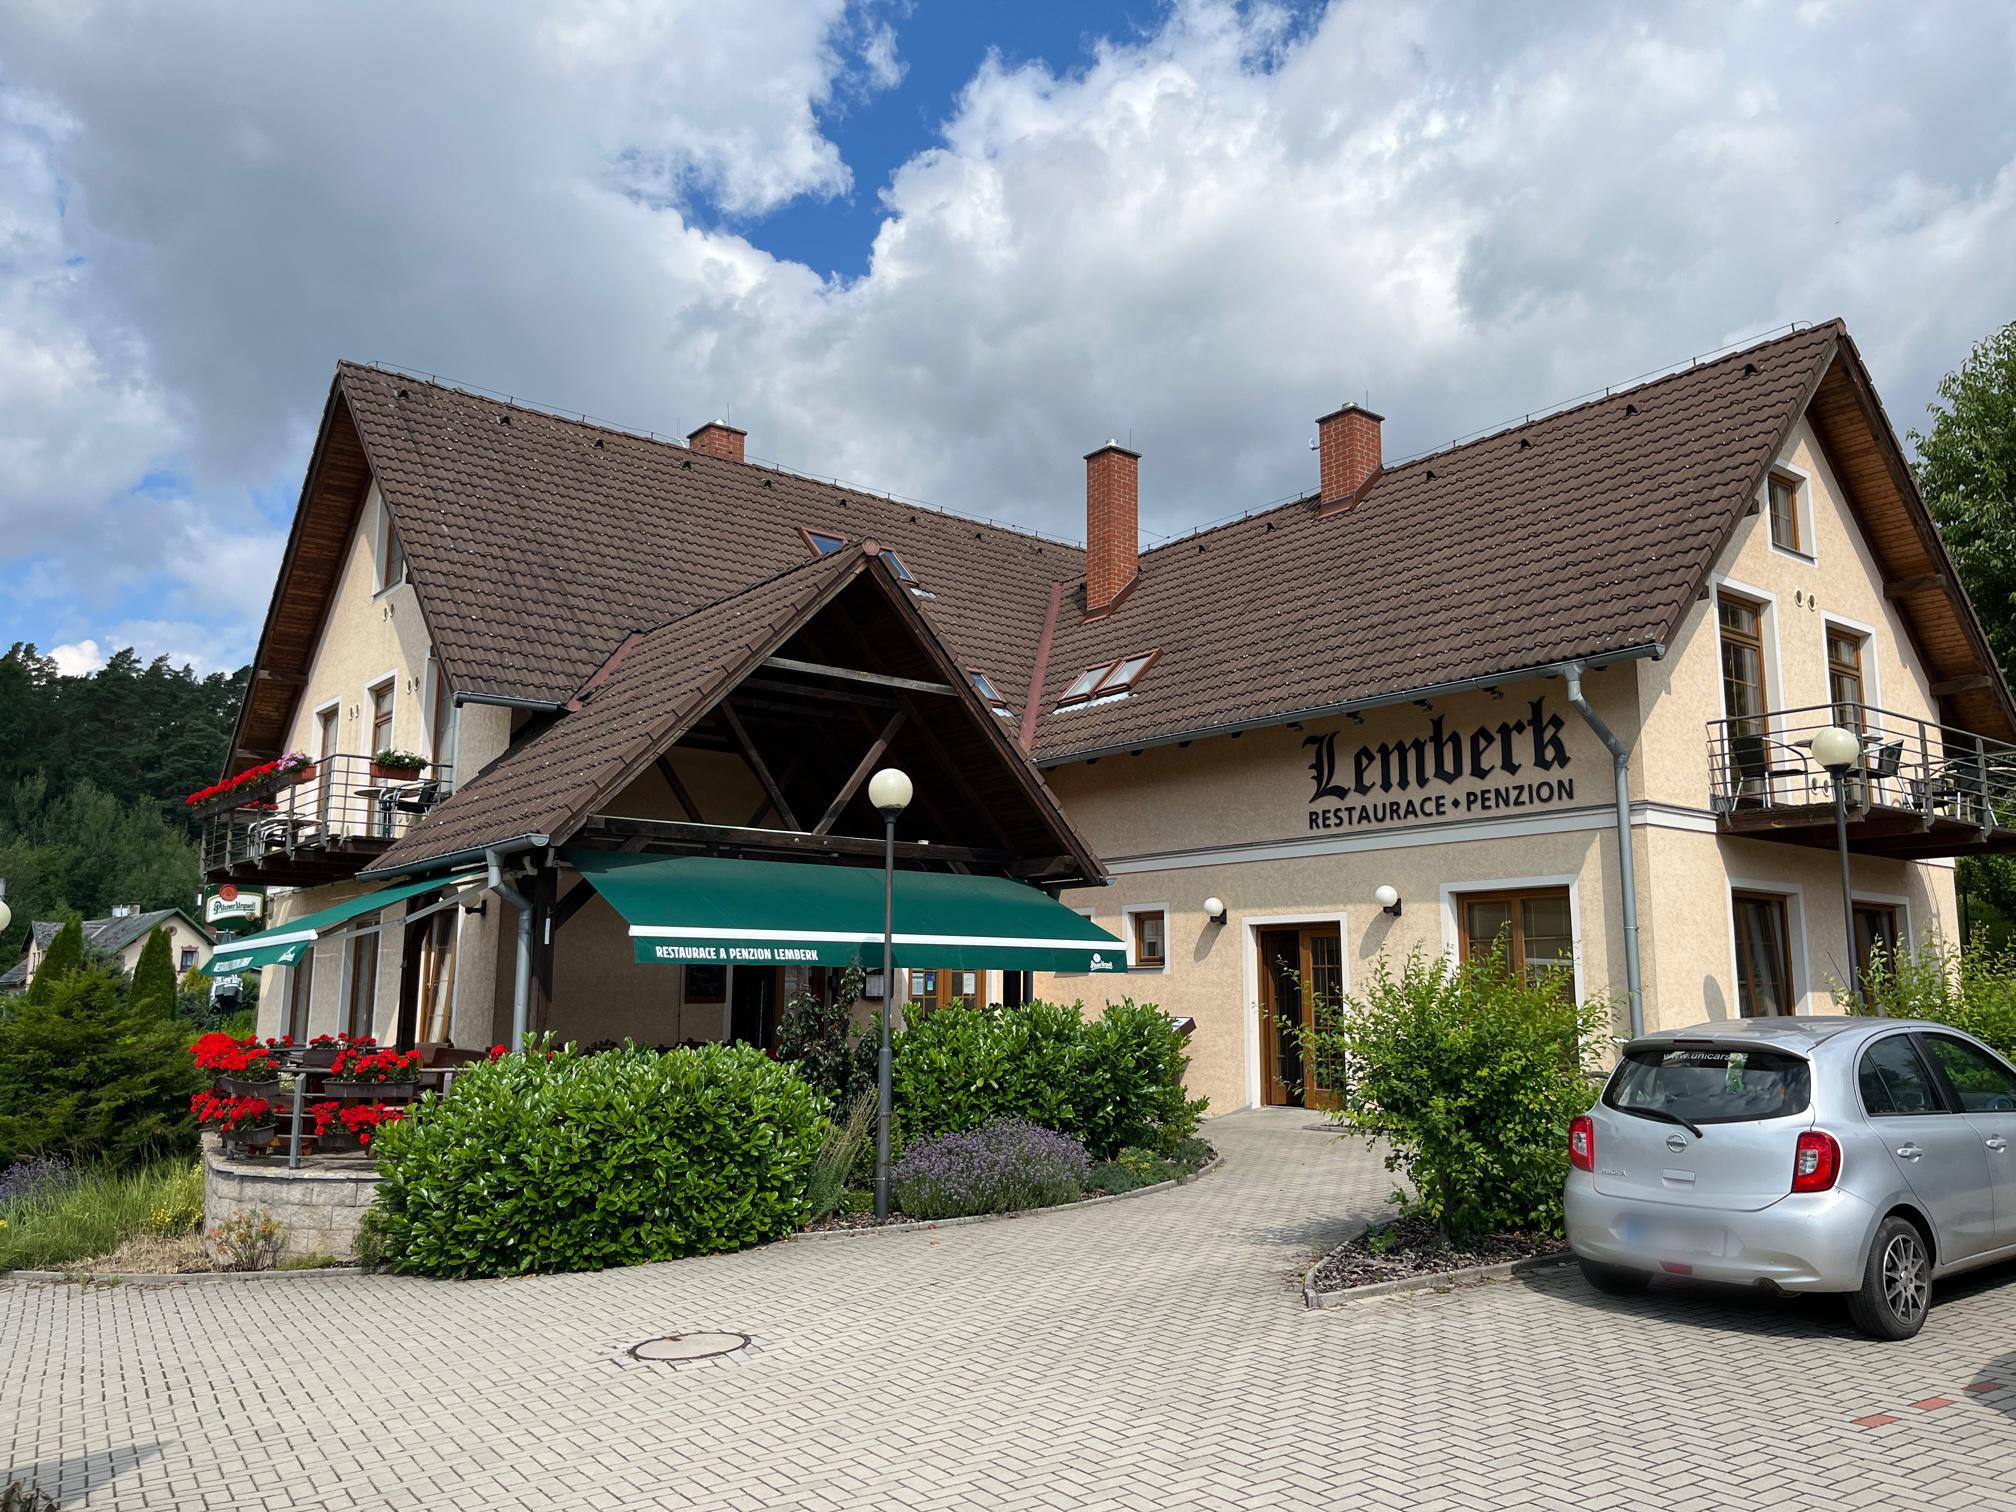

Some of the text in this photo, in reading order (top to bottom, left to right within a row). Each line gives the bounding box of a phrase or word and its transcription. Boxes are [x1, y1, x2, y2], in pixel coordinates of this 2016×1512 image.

[1302, 696, 1572, 803] Lemberk
[1308, 778, 1574, 829] RESTAURACE PENZION
[655, 946, 819, 961] RESTAURACE A PENZION LEMBERK
